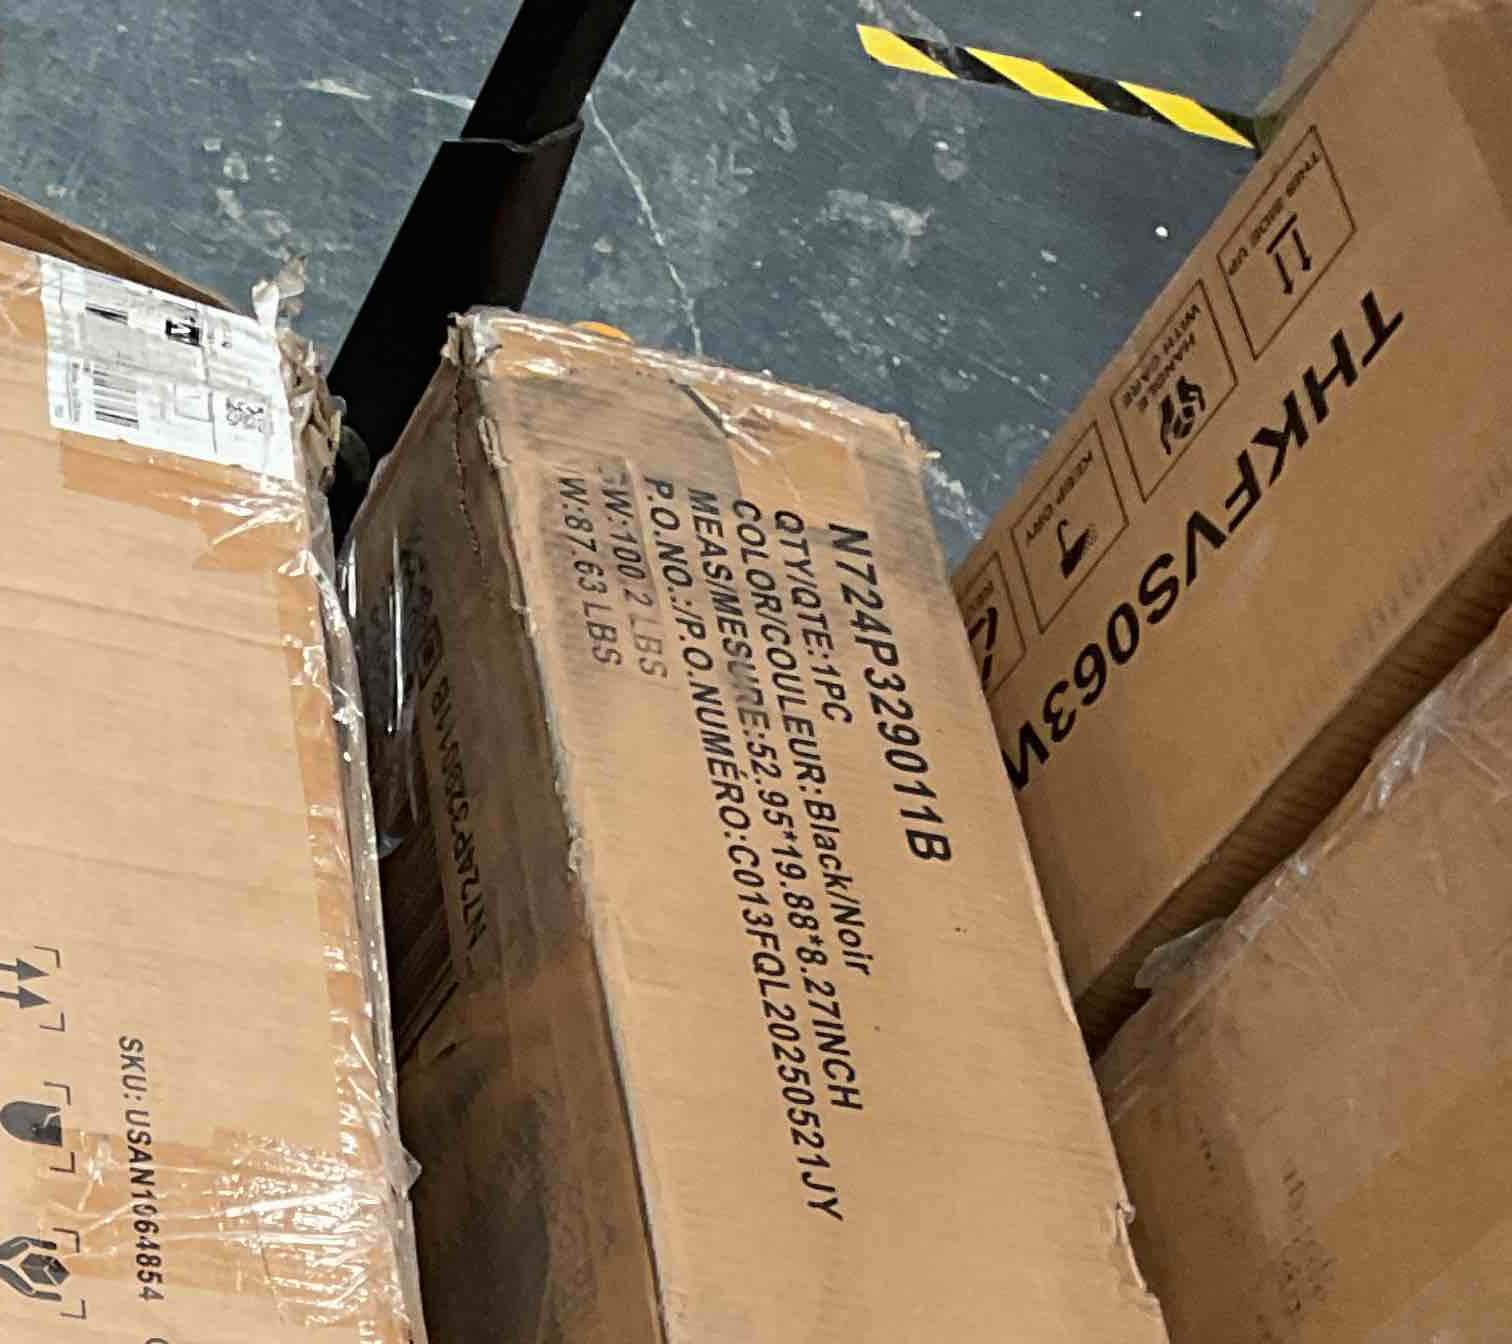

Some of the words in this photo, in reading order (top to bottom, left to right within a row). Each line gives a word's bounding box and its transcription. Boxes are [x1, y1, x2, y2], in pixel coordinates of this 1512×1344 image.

[582, 602, 624, 668] LBS
[628, 615, 668, 680] LBS
[774, 510, 853, 725] QTY/QTE:1PC
[828, 522, 952, 862] N724P329011B
[119, 1035, 149, 1101] SKU:
